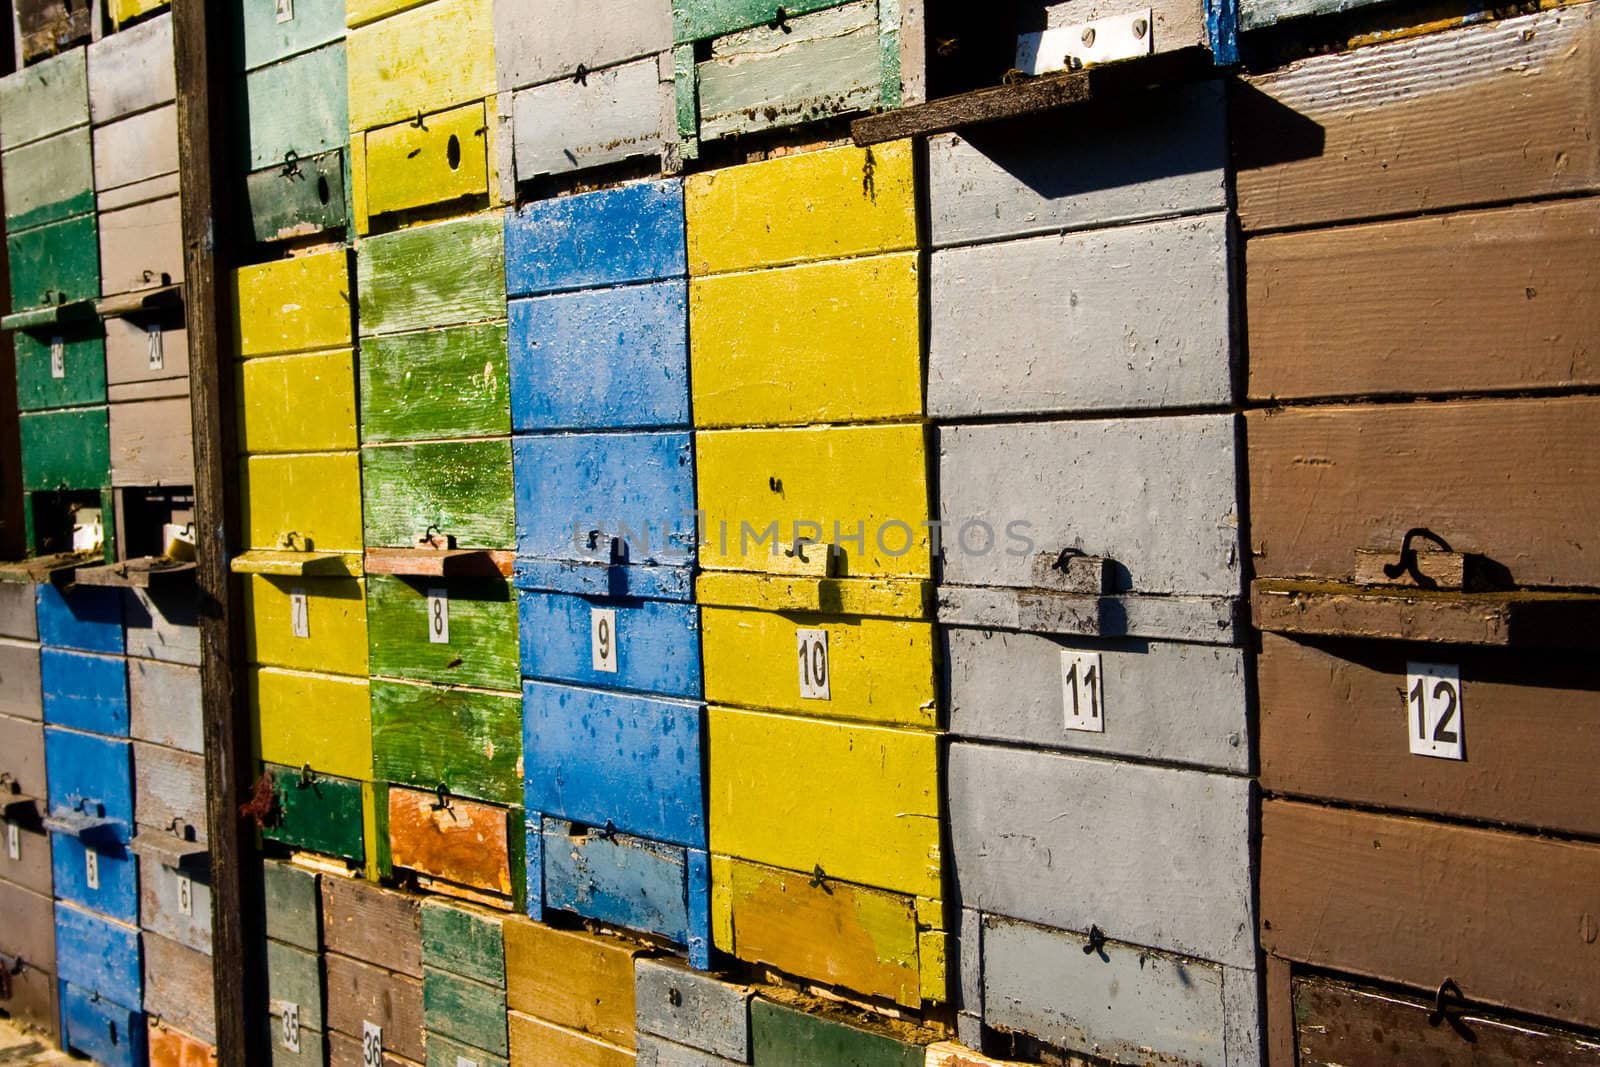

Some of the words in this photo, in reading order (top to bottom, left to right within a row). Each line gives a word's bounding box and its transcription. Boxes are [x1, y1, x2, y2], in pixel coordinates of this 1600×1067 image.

[149, 331, 161, 362] 20
[295, 597, 304, 631] 7
[434, 598, 443, 635] 8
[598, 618, 609, 660] 9
[799, 638, 826, 688] 10
[1066, 663, 1098, 718] 11
[1409, 678, 1458, 744] 12
[181, 879, 188, 909] 6
[282, 1009, 298, 1045] 35
[364, 1030, 381, 1067] 36
